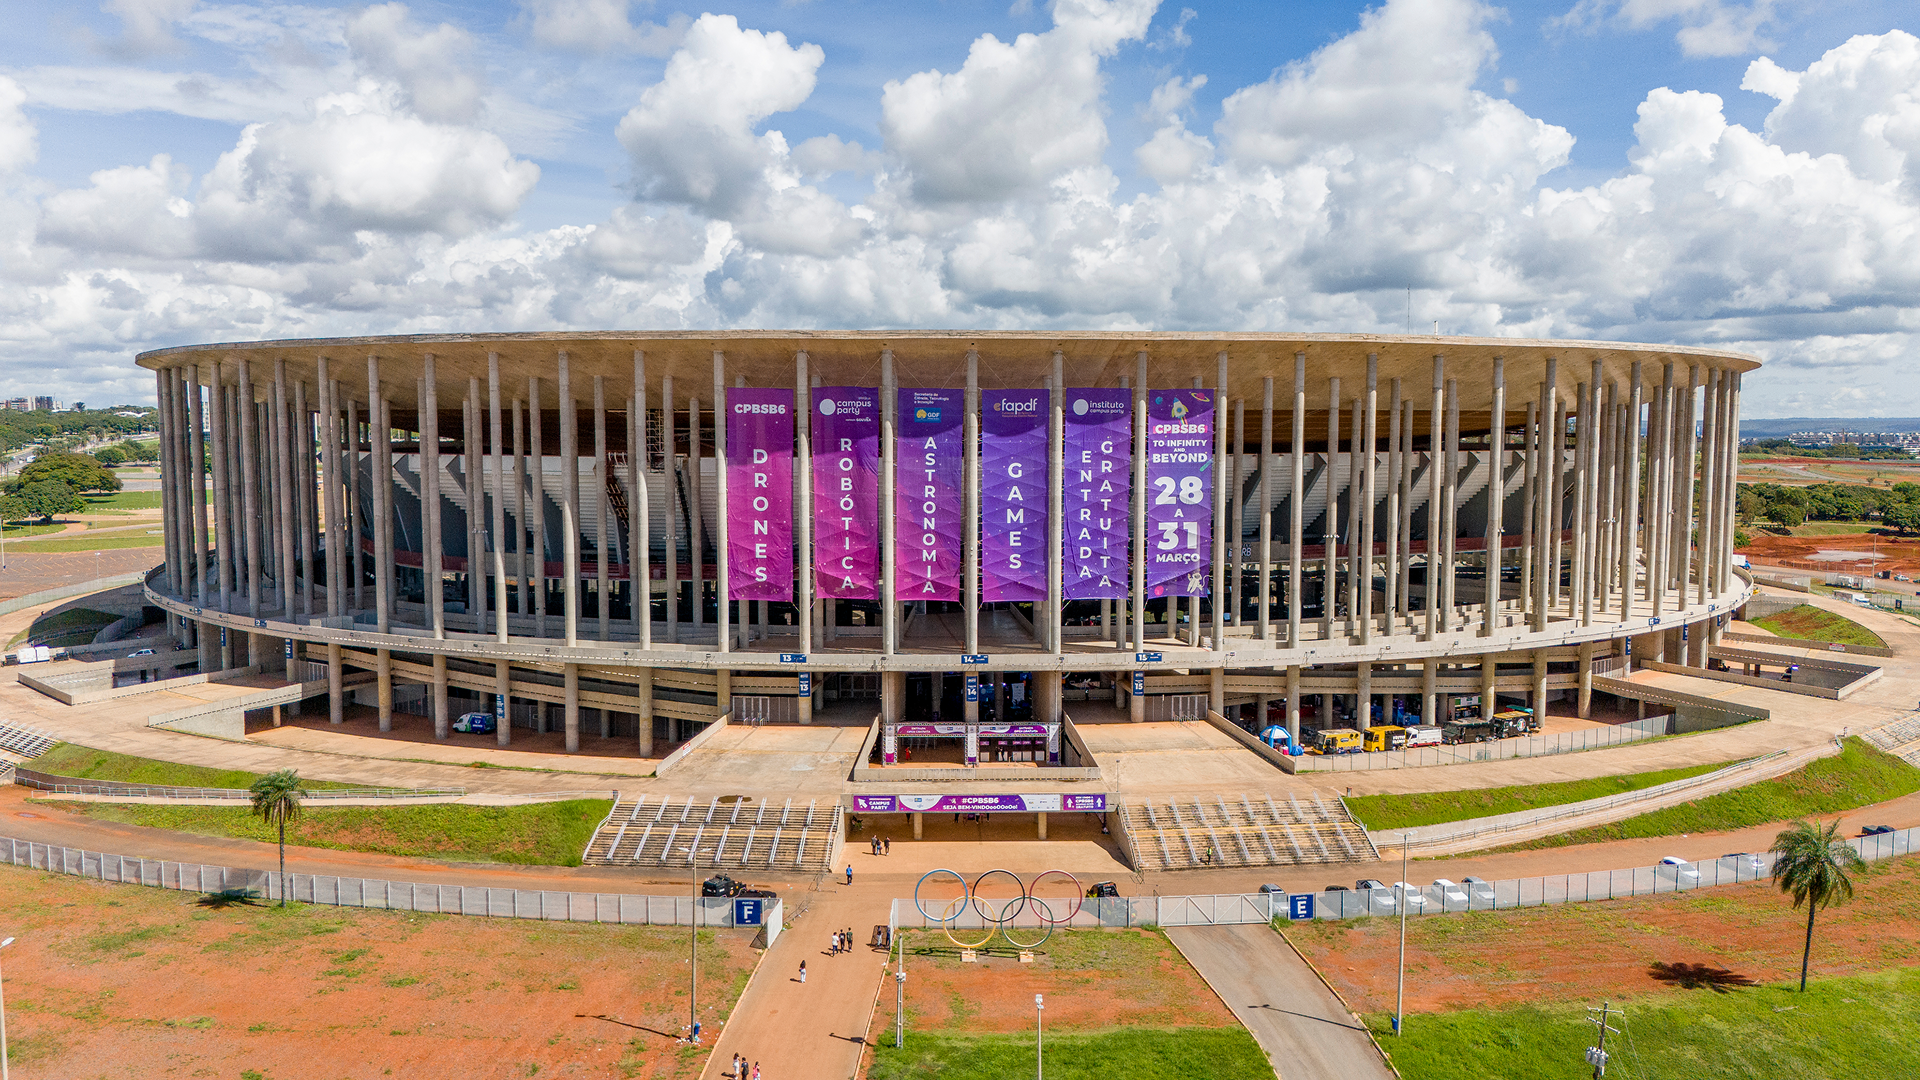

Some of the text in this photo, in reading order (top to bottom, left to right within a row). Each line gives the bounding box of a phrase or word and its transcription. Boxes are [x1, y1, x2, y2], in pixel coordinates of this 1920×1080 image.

[734, 403, 786, 414] CPBSB6
[837, 400, 871, 408] campus
[1001, 398, 1038, 415] fapdf
[1090, 401, 1124, 409] instituto
[837, 406, 860, 415] party
[1155, 424, 1206, 434] CPBSB6
[1152, 453, 1208, 463] BEYOND
[1153, 475, 1204, 505] 28
[753, 449, 769, 582] DRONES
[839, 438, 854, 589] ROBÓTICA
[922, 436, 938, 594] ASTRONOMIA
[1006, 462, 1024, 570] GAMES
[1078, 450, 1092, 579] ENTRADA
[1098, 440, 1113, 588] GRATUITA
[1173, 508, 1184, 518] A
[1157, 521, 1198, 550] 31
[1155, 553, 1201, 564] MARÇO
[782, 654, 792, 662] 13
[1138, 653, 1148, 661] 15
[1134, 682, 1143, 690] 15
[967, 688, 977, 696] 14
[744, 906, 753, 919] F
[1298, 901, 1307, 914] E
